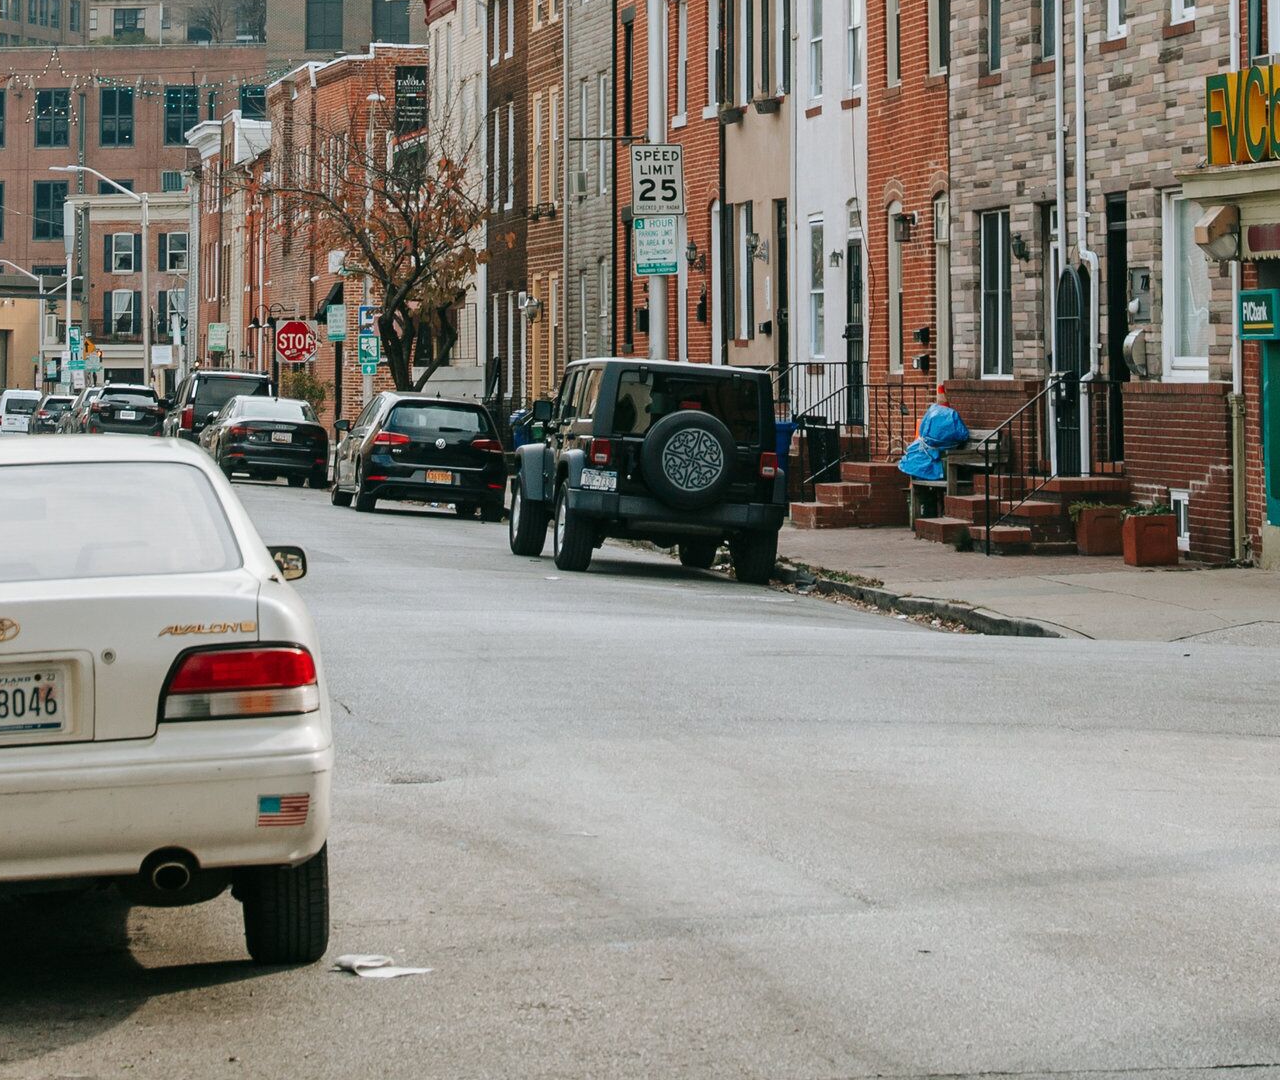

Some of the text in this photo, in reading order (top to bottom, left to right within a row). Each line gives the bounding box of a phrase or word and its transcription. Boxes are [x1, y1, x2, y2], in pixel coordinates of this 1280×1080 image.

[634, 150, 680, 161] SPEED
[640, 164, 674, 175] LIMIT
[638, 178, 678, 202] 25
[637, 219, 674, 229] 3 HOUR
[1242, 301, 1268, 321] FVCbank
[158, 622, 238, 636] AVALON
